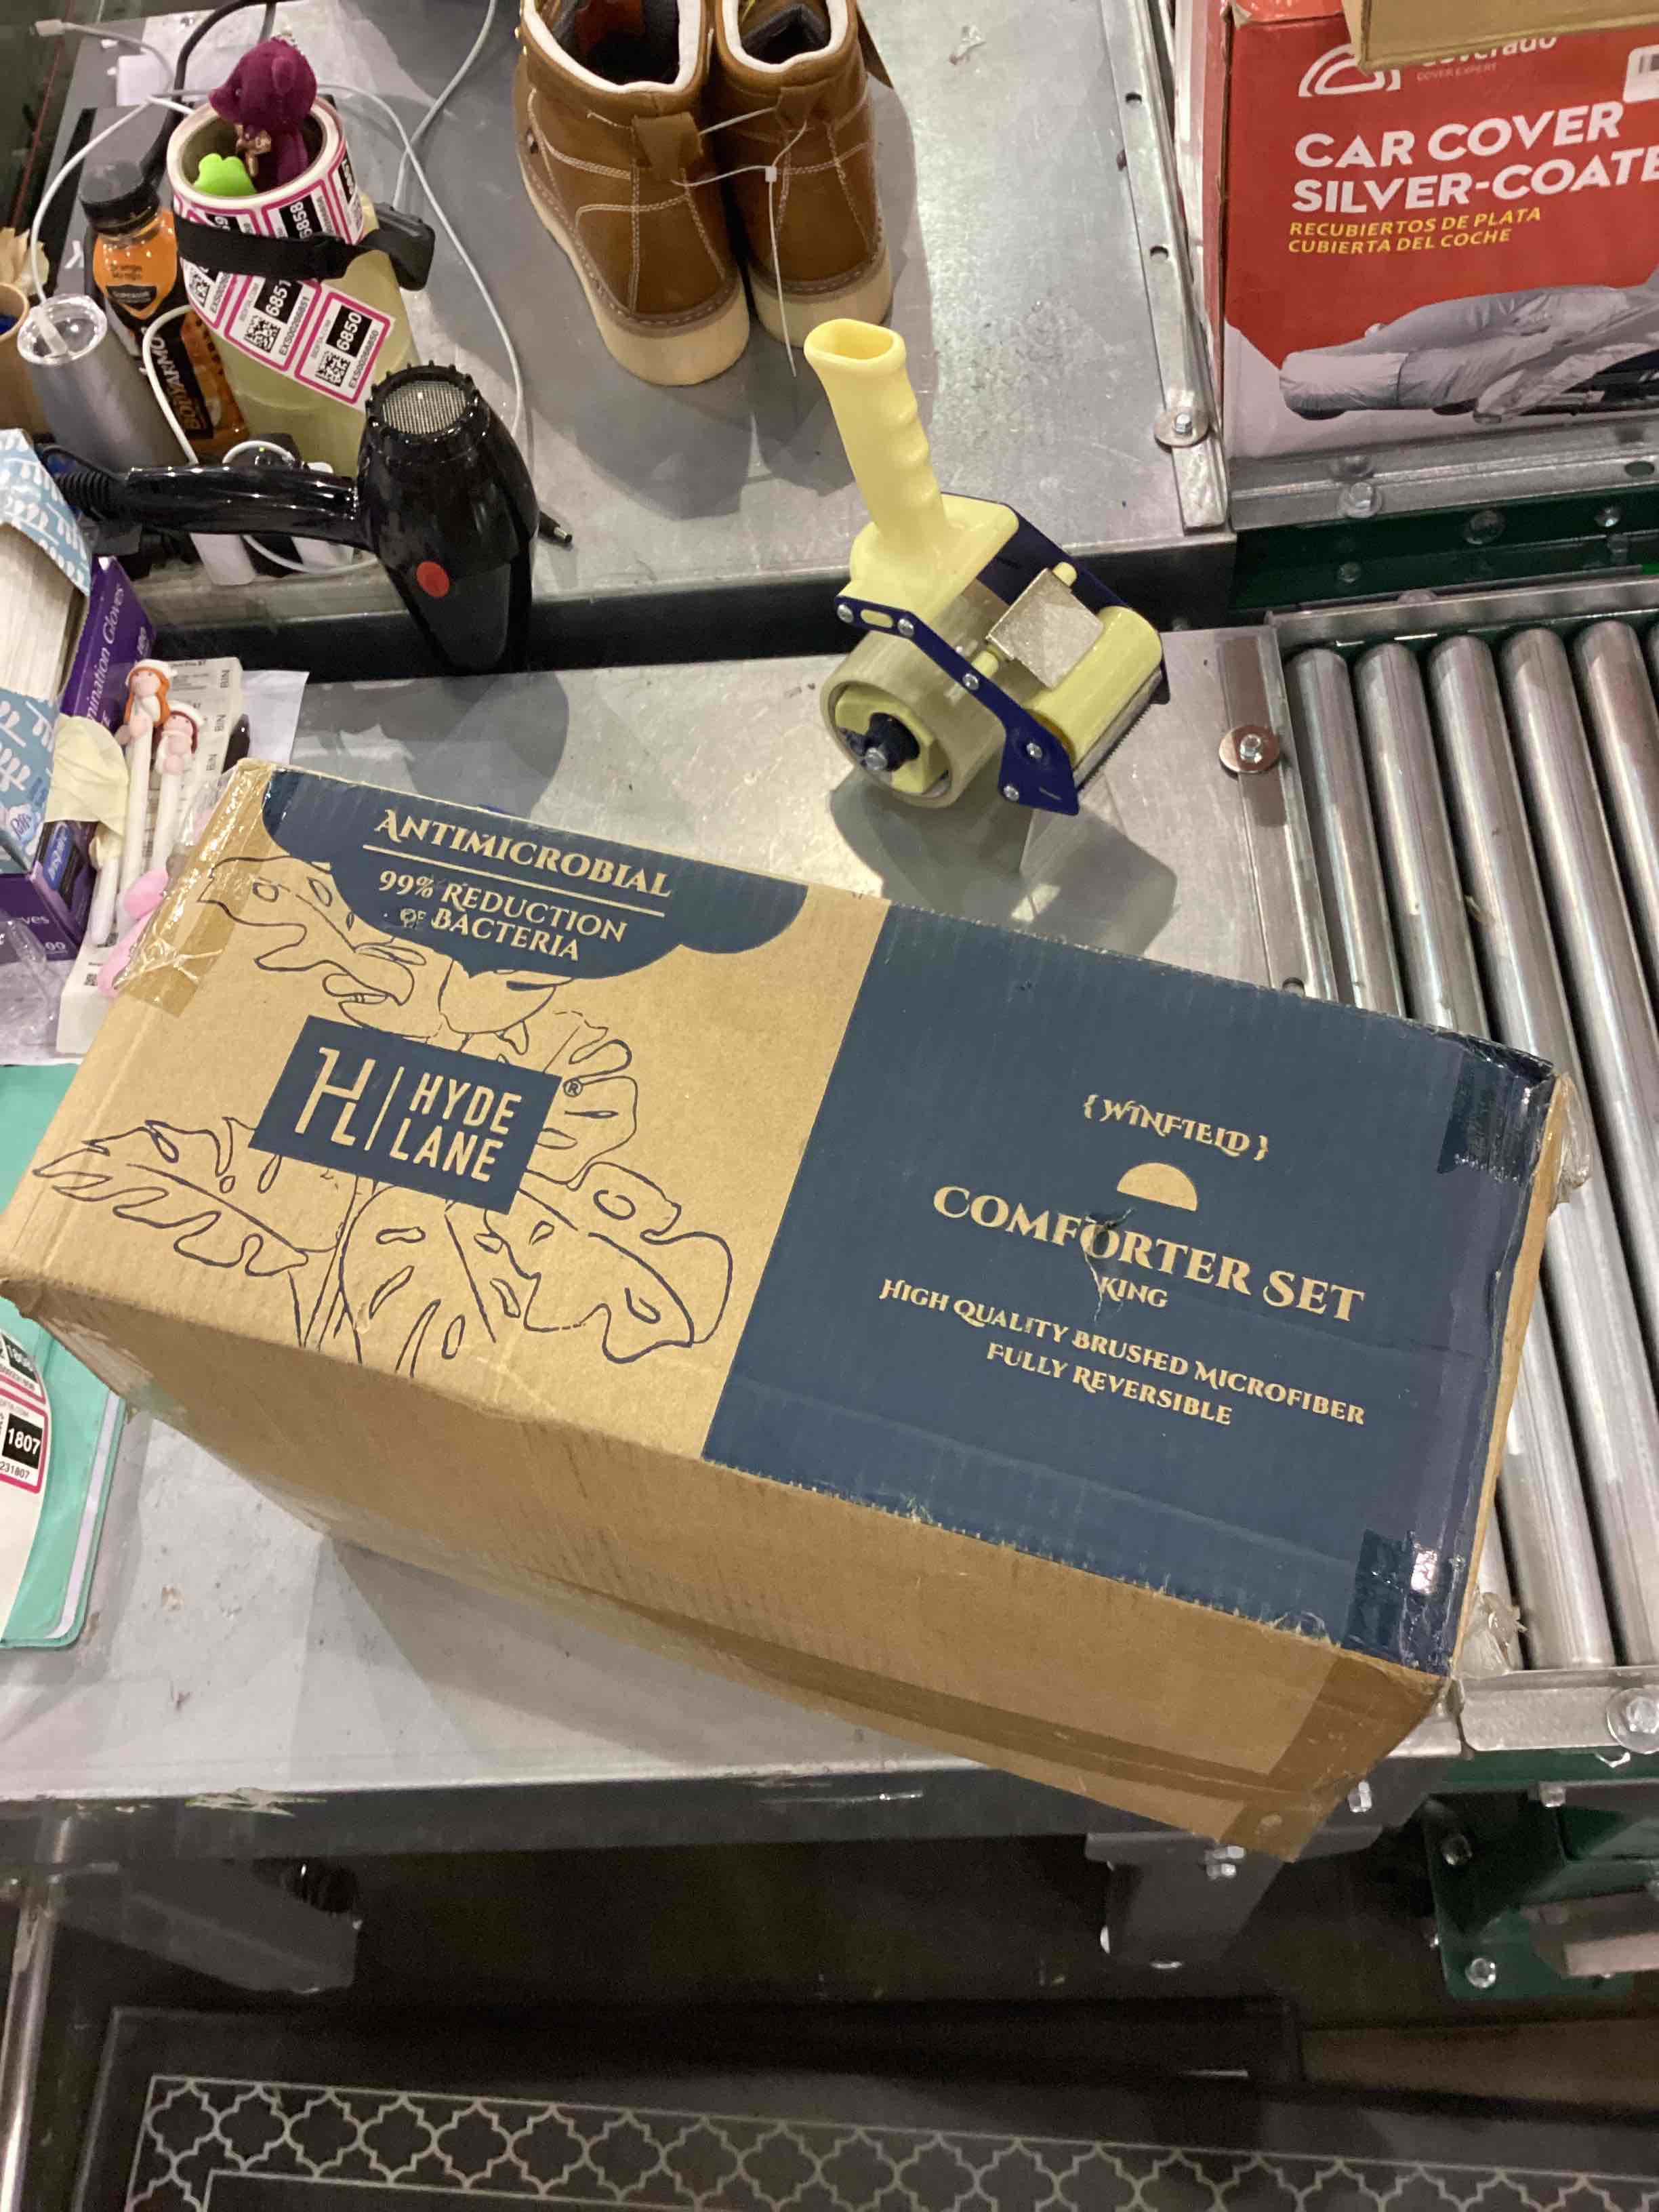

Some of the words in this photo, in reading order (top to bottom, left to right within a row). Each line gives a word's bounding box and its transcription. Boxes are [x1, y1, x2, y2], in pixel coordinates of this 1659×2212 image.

[1295, 129, 1416, 169] CAR
[1427, 100, 1624, 161] COVER
[1288, 236, 1391, 255] CUBIERTA
[1396, 237, 1433, 251] DEL
[1440, 228, 1512, 248] COCHE
[1290, 218, 1437, 238] RECUBIERTOS
[1441, 215, 1470, 230] DE
[1473, 206, 1542, 228] PLATA
[265, 279, 292, 316] 6851
[336, 311, 362, 351] 6850
[102, 583, 125, 645] Gloves
[374, 808, 673, 898] ANTIMICROBIAL
[378, 869, 434, 899] 99%
[441, 882, 628, 943] REDUCTION
[430, 907, 579, 961] BACTERIA
[409, 1071, 522, 1135] HYDE
[390, 1117, 504, 1183] LANE
[933, 1185, 1252, 1296] COMFORTER
[1263, 1269, 1365, 1323] SET
[1098, 1275, 1169, 1309] KING
[879, 1277, 949, 1313] HIGH
[953, 1299, 1069, 1345] QUALITY
[1071, 1330, 1189, 1377] BRUSHED
[1194, 1360, 1366, 1425] MICROFIBER
[986, 1343, 1069, 1380] FULLY
[1071, 1366, 1233, 1427] REVERSIBLE
[8, 1427, 41, 1455] 1807
